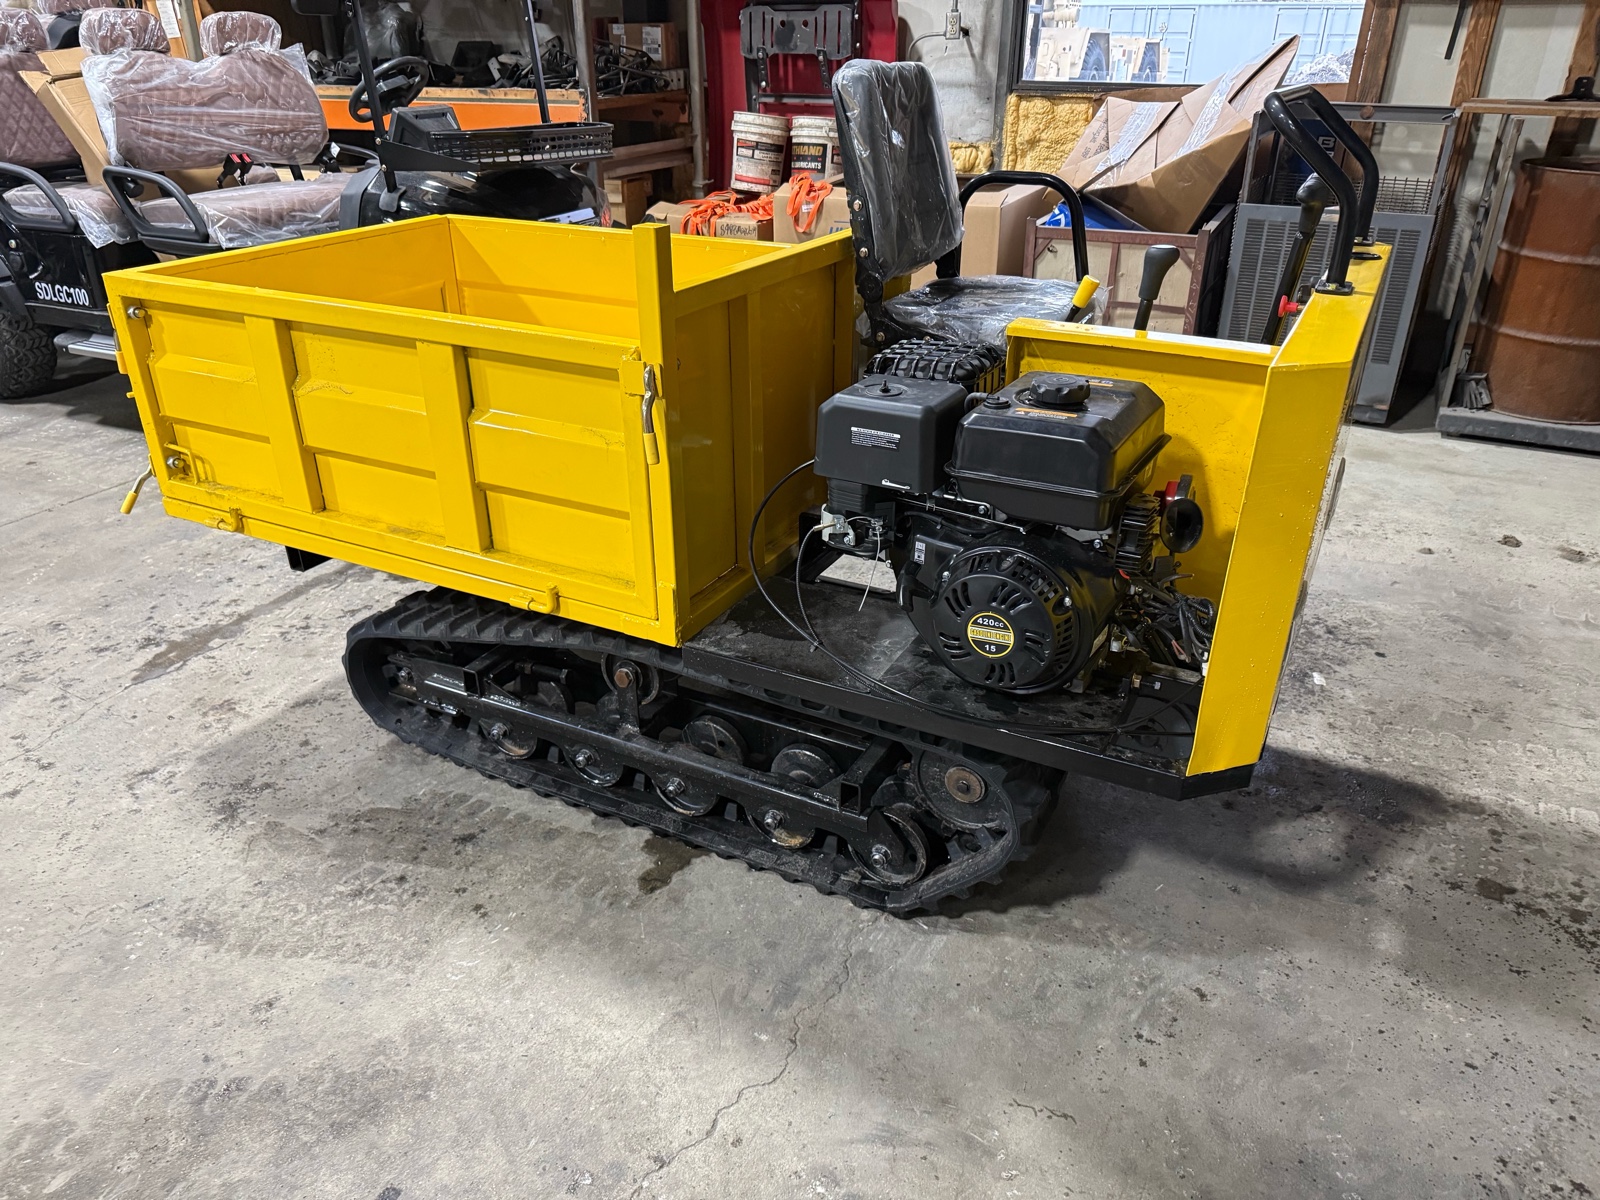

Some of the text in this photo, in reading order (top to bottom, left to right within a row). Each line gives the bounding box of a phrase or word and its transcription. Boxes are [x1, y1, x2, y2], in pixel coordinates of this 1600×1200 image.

[35, 281, 89, 306] SDLGC100
[977, 617, 1004, 628] 420cc
[985, 644, 997, 652] 15
